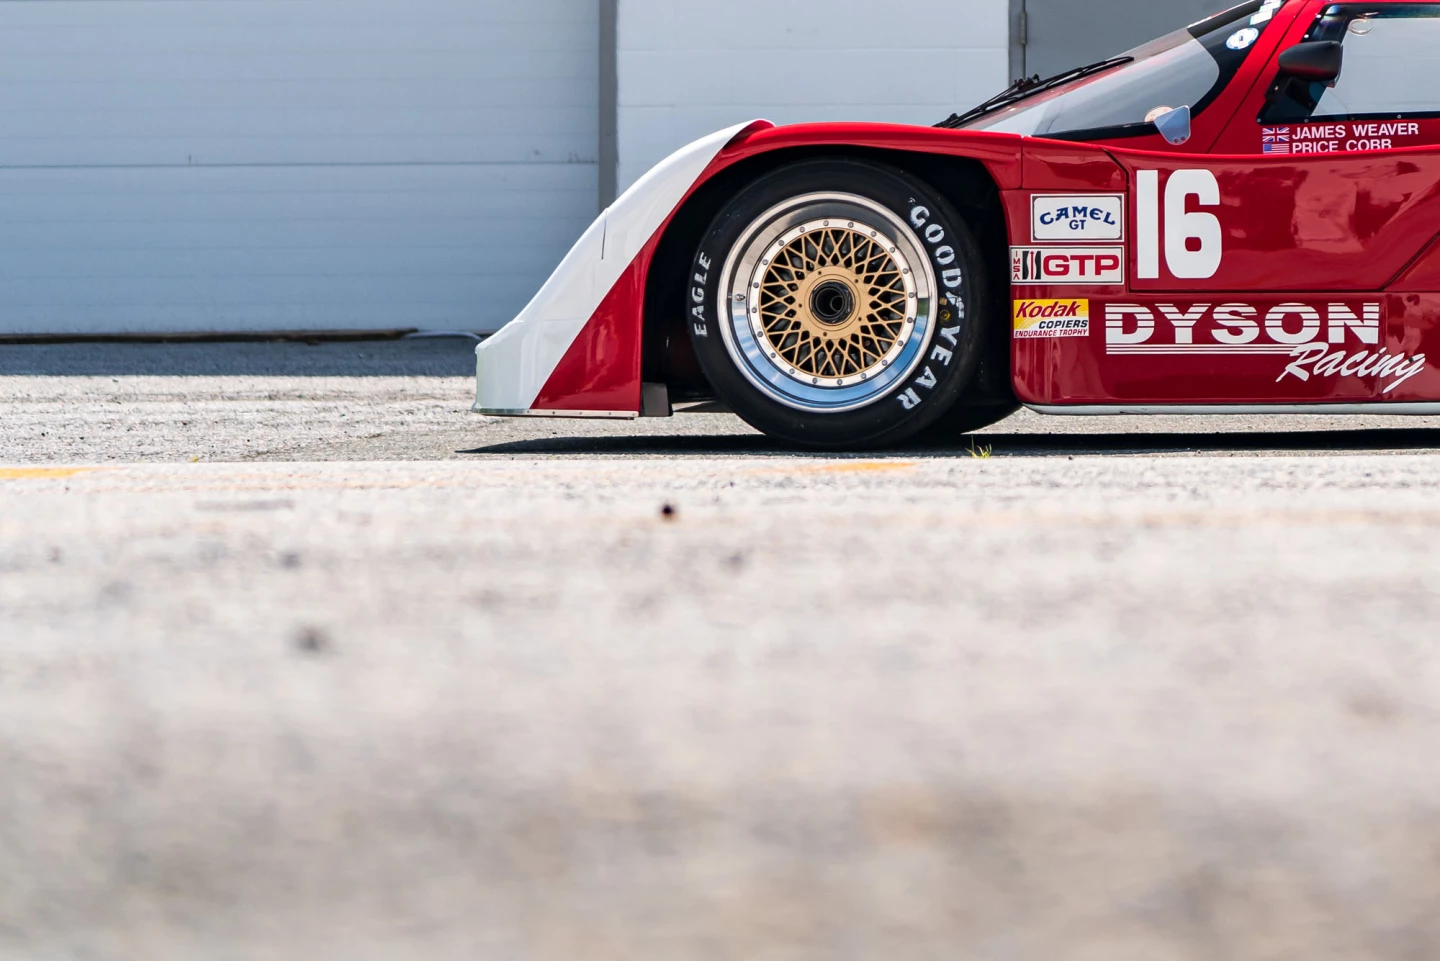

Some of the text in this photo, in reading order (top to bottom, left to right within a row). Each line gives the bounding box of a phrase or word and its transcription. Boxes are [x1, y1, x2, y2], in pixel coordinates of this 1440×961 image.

[1292, 123, 1419, 140] JAMES WEAVER
[1292, 141, 1339, 154] PRICE
[1039, 206, 1116, 226] CAMEL
[1069, 219, 1087, 230] GT
[1136, 169, 1222, 279] 16
[1043, 255, 1119, 276] GTP
[693, 251, 712, 338] EAGLE
[896, 204, 965, 410] GOODYEAR
[1015, 301, 1081, 318] Kodak
[1038, 320, 1089, 329] COPIERS
[1105, 302, 1380, 344] DYSON
[1276, 342, 1426, 393] Racing
